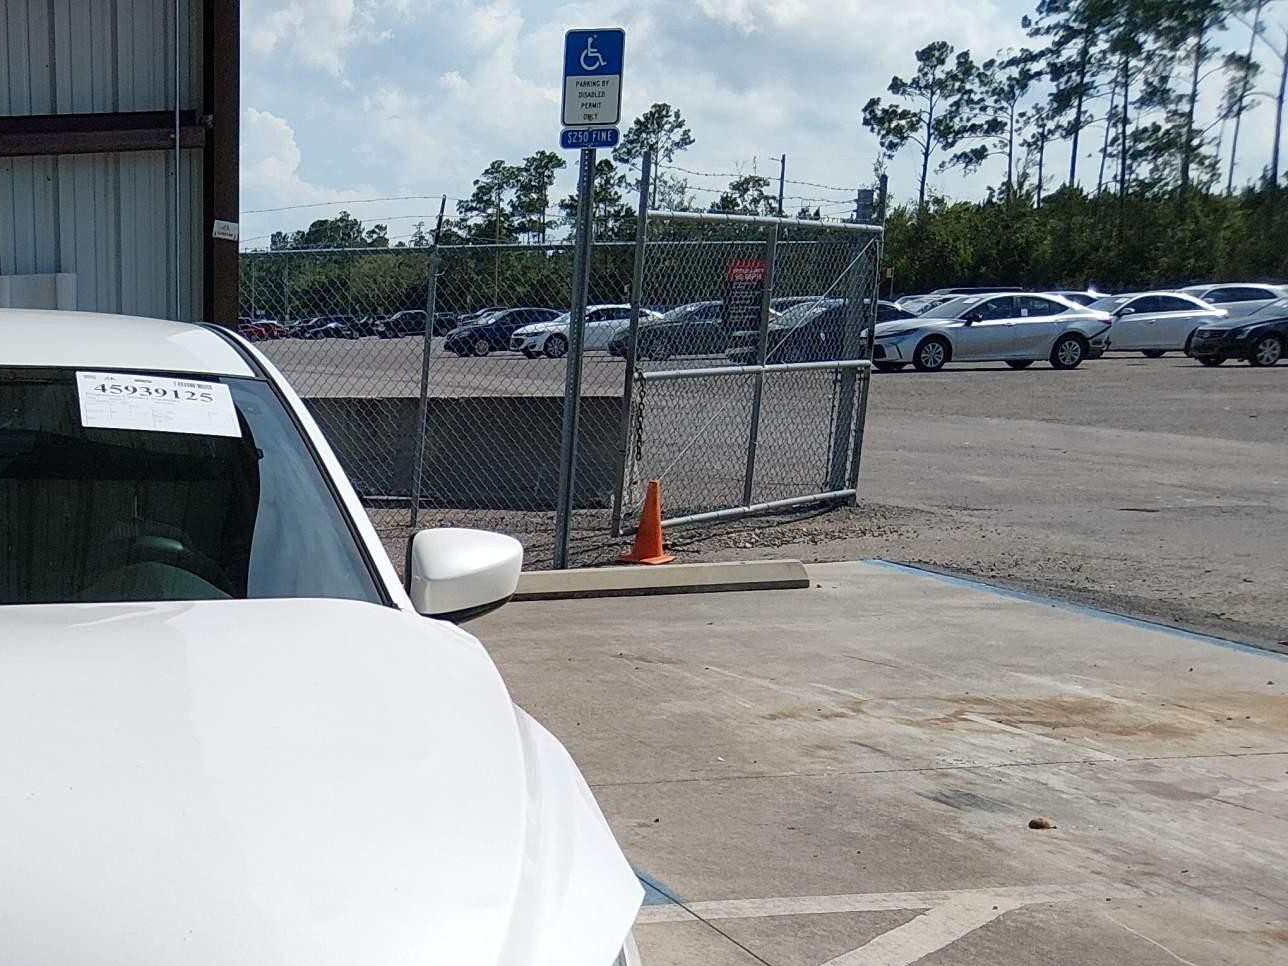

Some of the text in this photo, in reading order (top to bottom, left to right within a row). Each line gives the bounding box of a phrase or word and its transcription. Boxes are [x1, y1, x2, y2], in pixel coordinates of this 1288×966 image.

[576, 79, 609, 88] PARKING BY
[583, 113, 598, 121] ONLY
[567, 130, 612, 144] $250 FINE
[94, 383, 214, 403] 45939125
